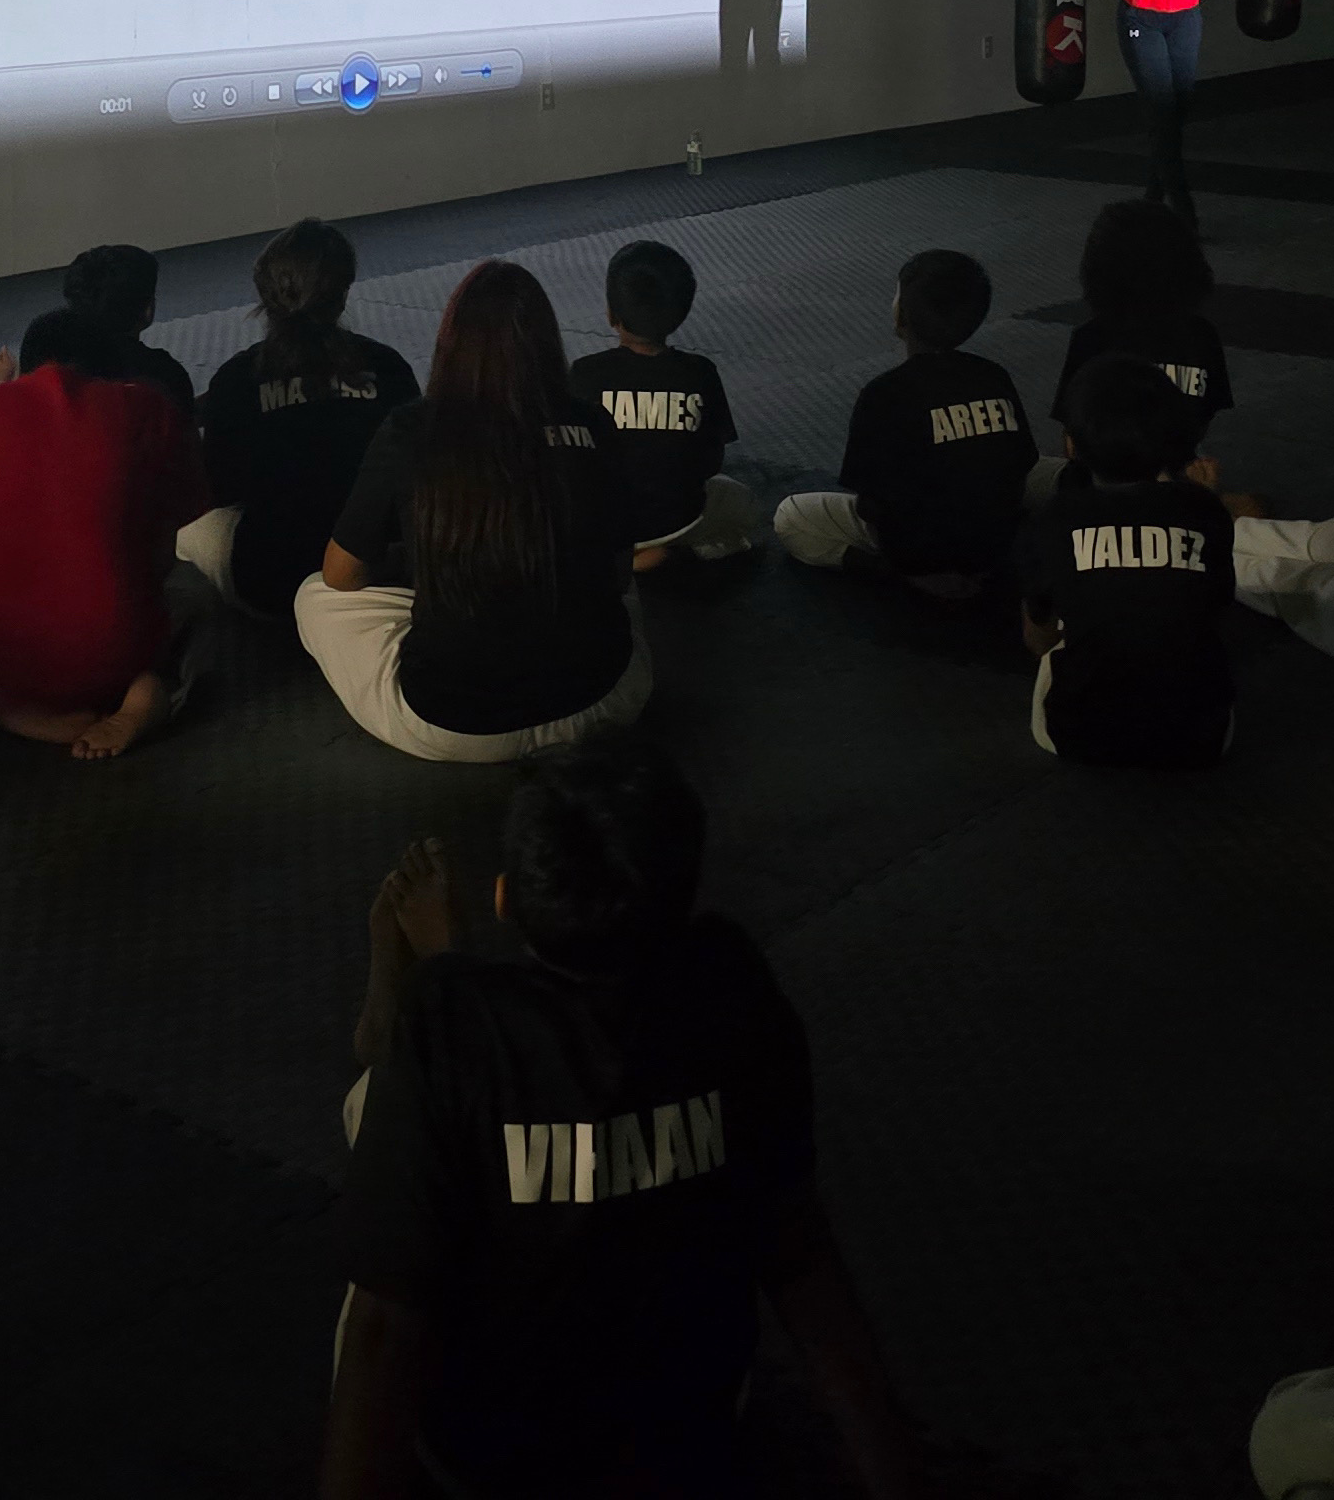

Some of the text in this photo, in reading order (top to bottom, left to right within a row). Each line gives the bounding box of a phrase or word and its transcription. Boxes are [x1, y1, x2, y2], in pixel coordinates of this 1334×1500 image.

[99, 97, 132, 114] 00:01
[1071, 525, 1206, 573] VALDEZ
[504, 1089, 726, 1205] VIHAAN
